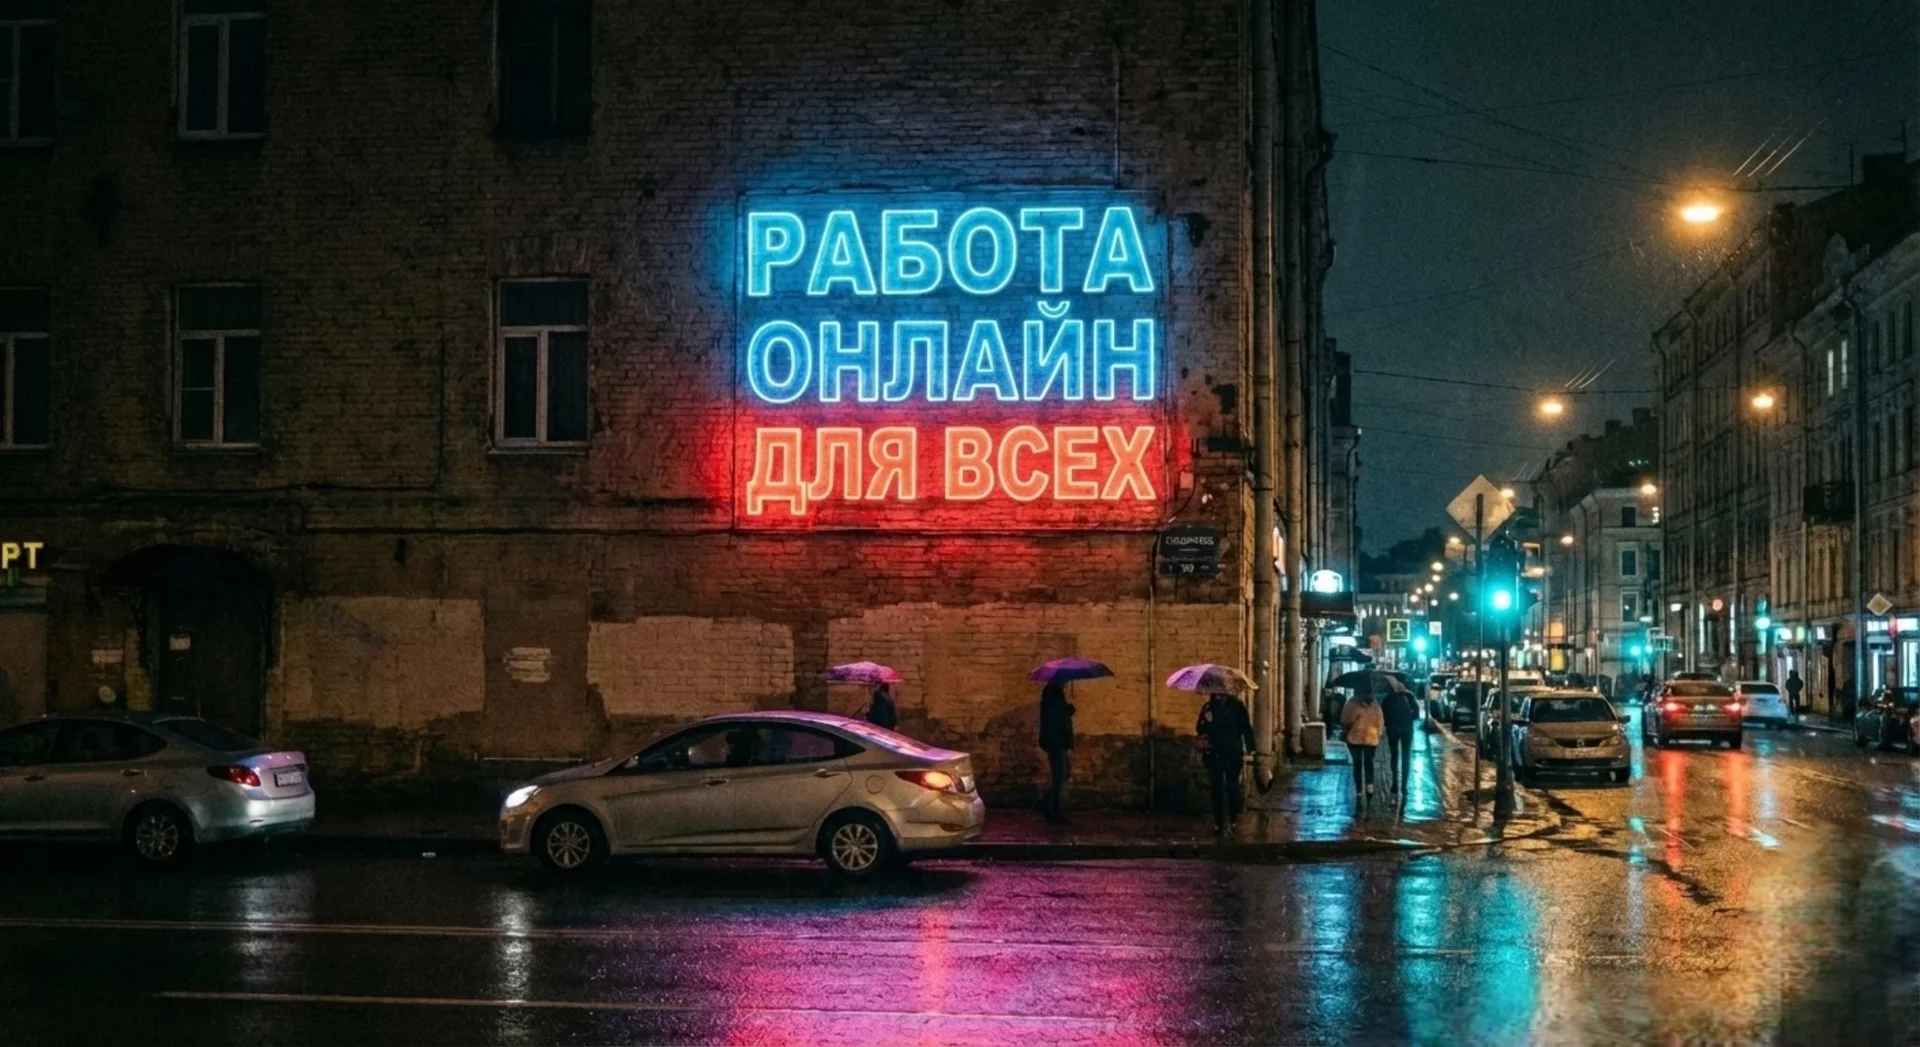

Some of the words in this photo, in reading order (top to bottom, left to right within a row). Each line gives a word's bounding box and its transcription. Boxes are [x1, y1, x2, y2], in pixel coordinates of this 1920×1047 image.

[747, 206, 1155, 297] РАБОТА
[747, 300, 1155, 404] ОНЛАЙН
[746, 426, 917, 516] ДЛЯ
[944, 425, 1157, 501] ВСЕХ
